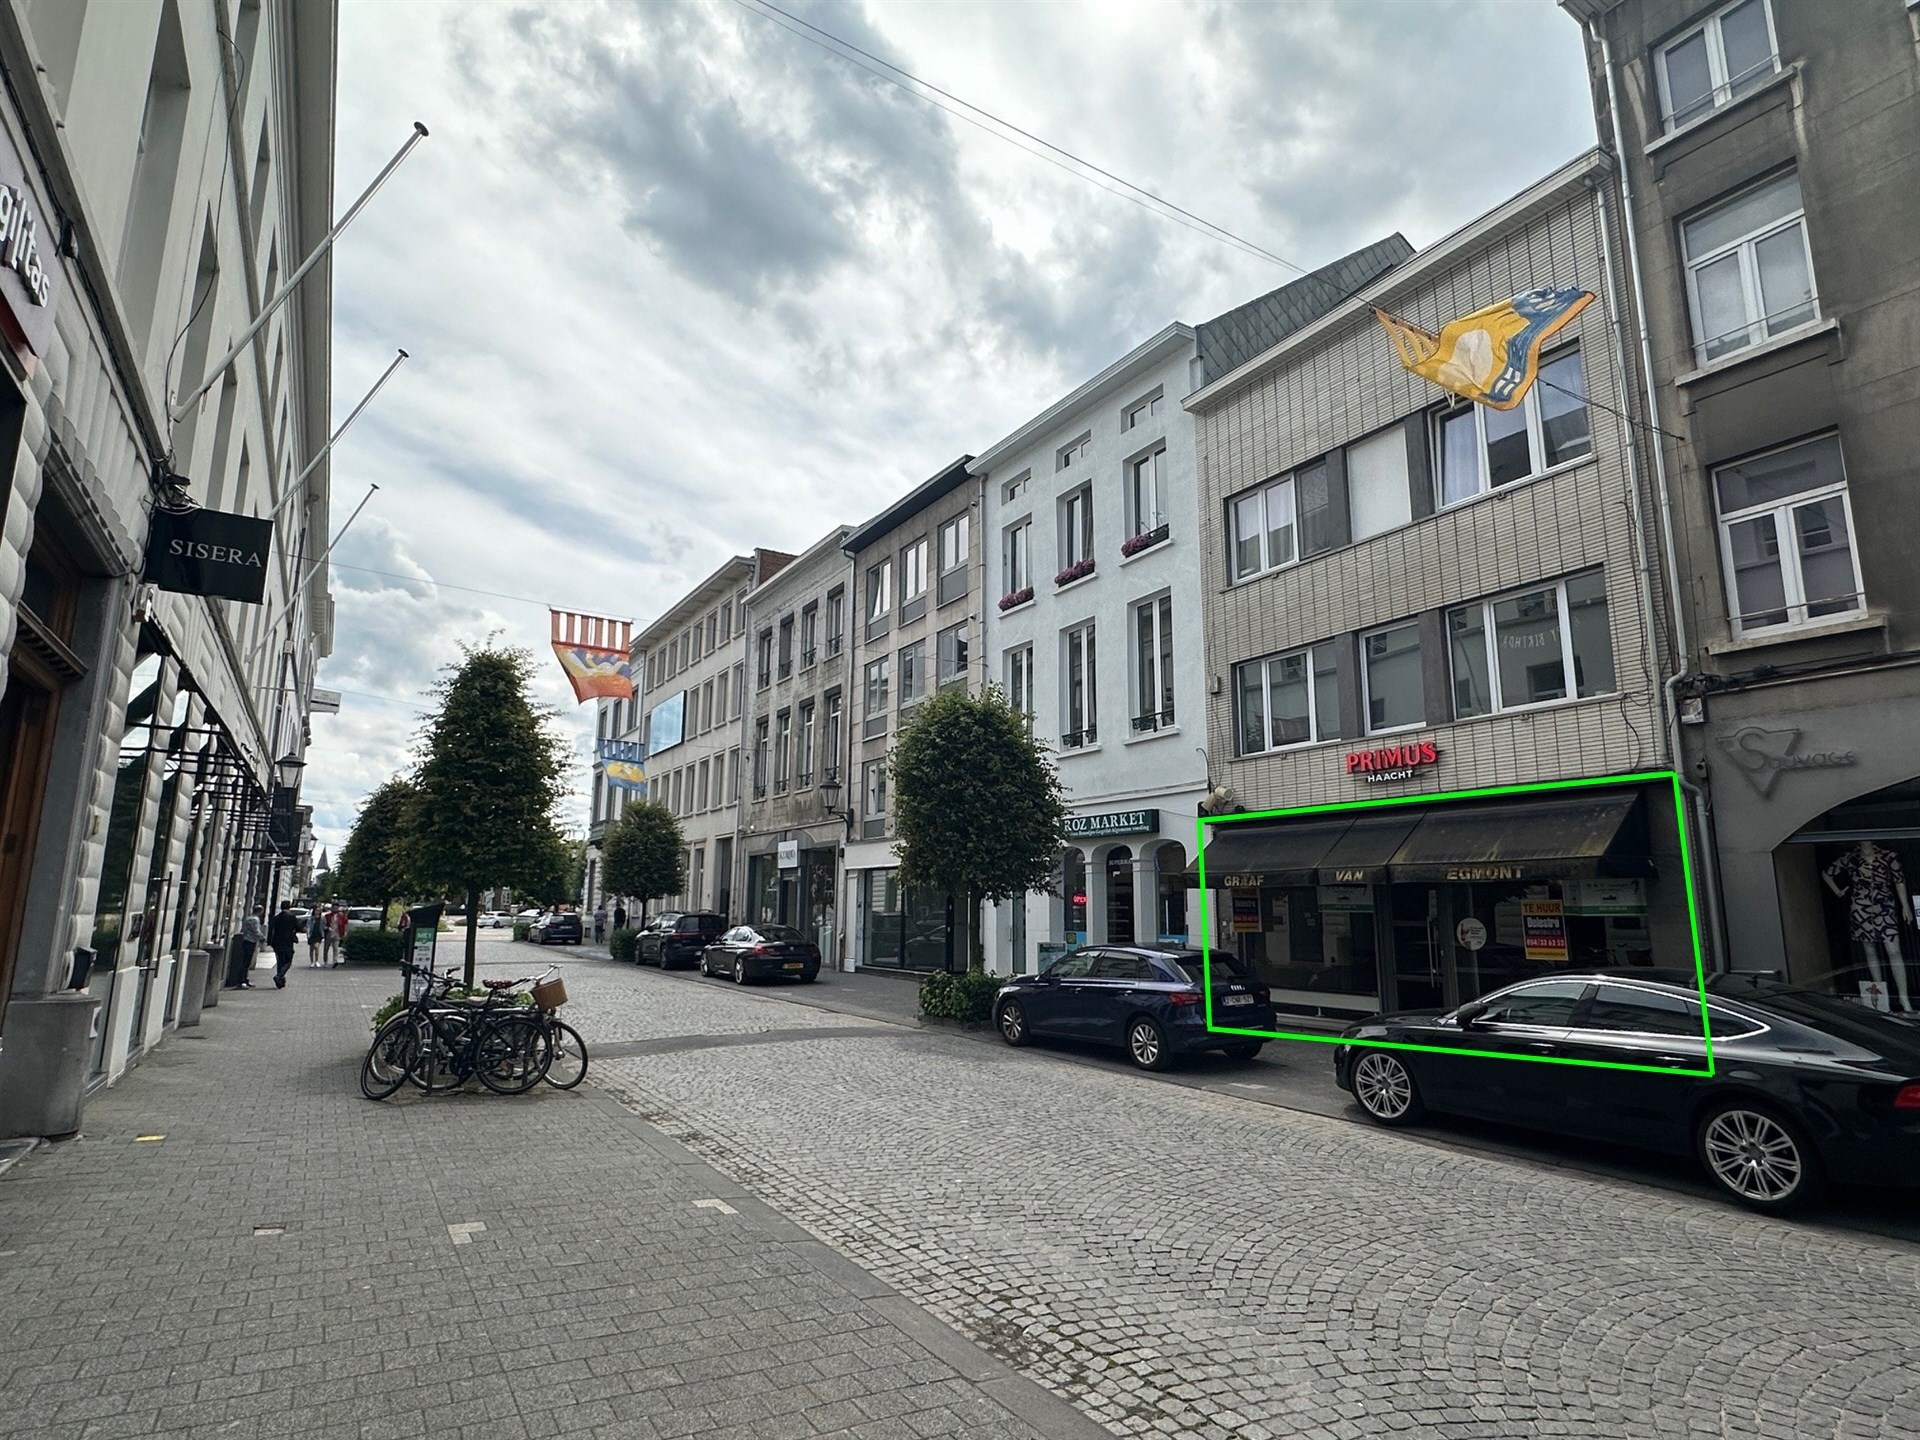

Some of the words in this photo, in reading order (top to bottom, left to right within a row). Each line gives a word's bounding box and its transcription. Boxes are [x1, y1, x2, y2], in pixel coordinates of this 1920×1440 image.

[169, 539, 262, 568] SISERA
[1346, 741, 1438, 774] PRIMUS
[1367, 770, 1413, 783] HAACHT
[1090, 811, 1146, 829] MARKET
[1223, 875, 1264, 887] GRAAF
[1335, 870, 1364, 881] VAN
[1446, 866, 1525, 880] EGMONT
[1523, 903, 1534, 913] TE
[1539, 903, 1561, 913] HUUR
